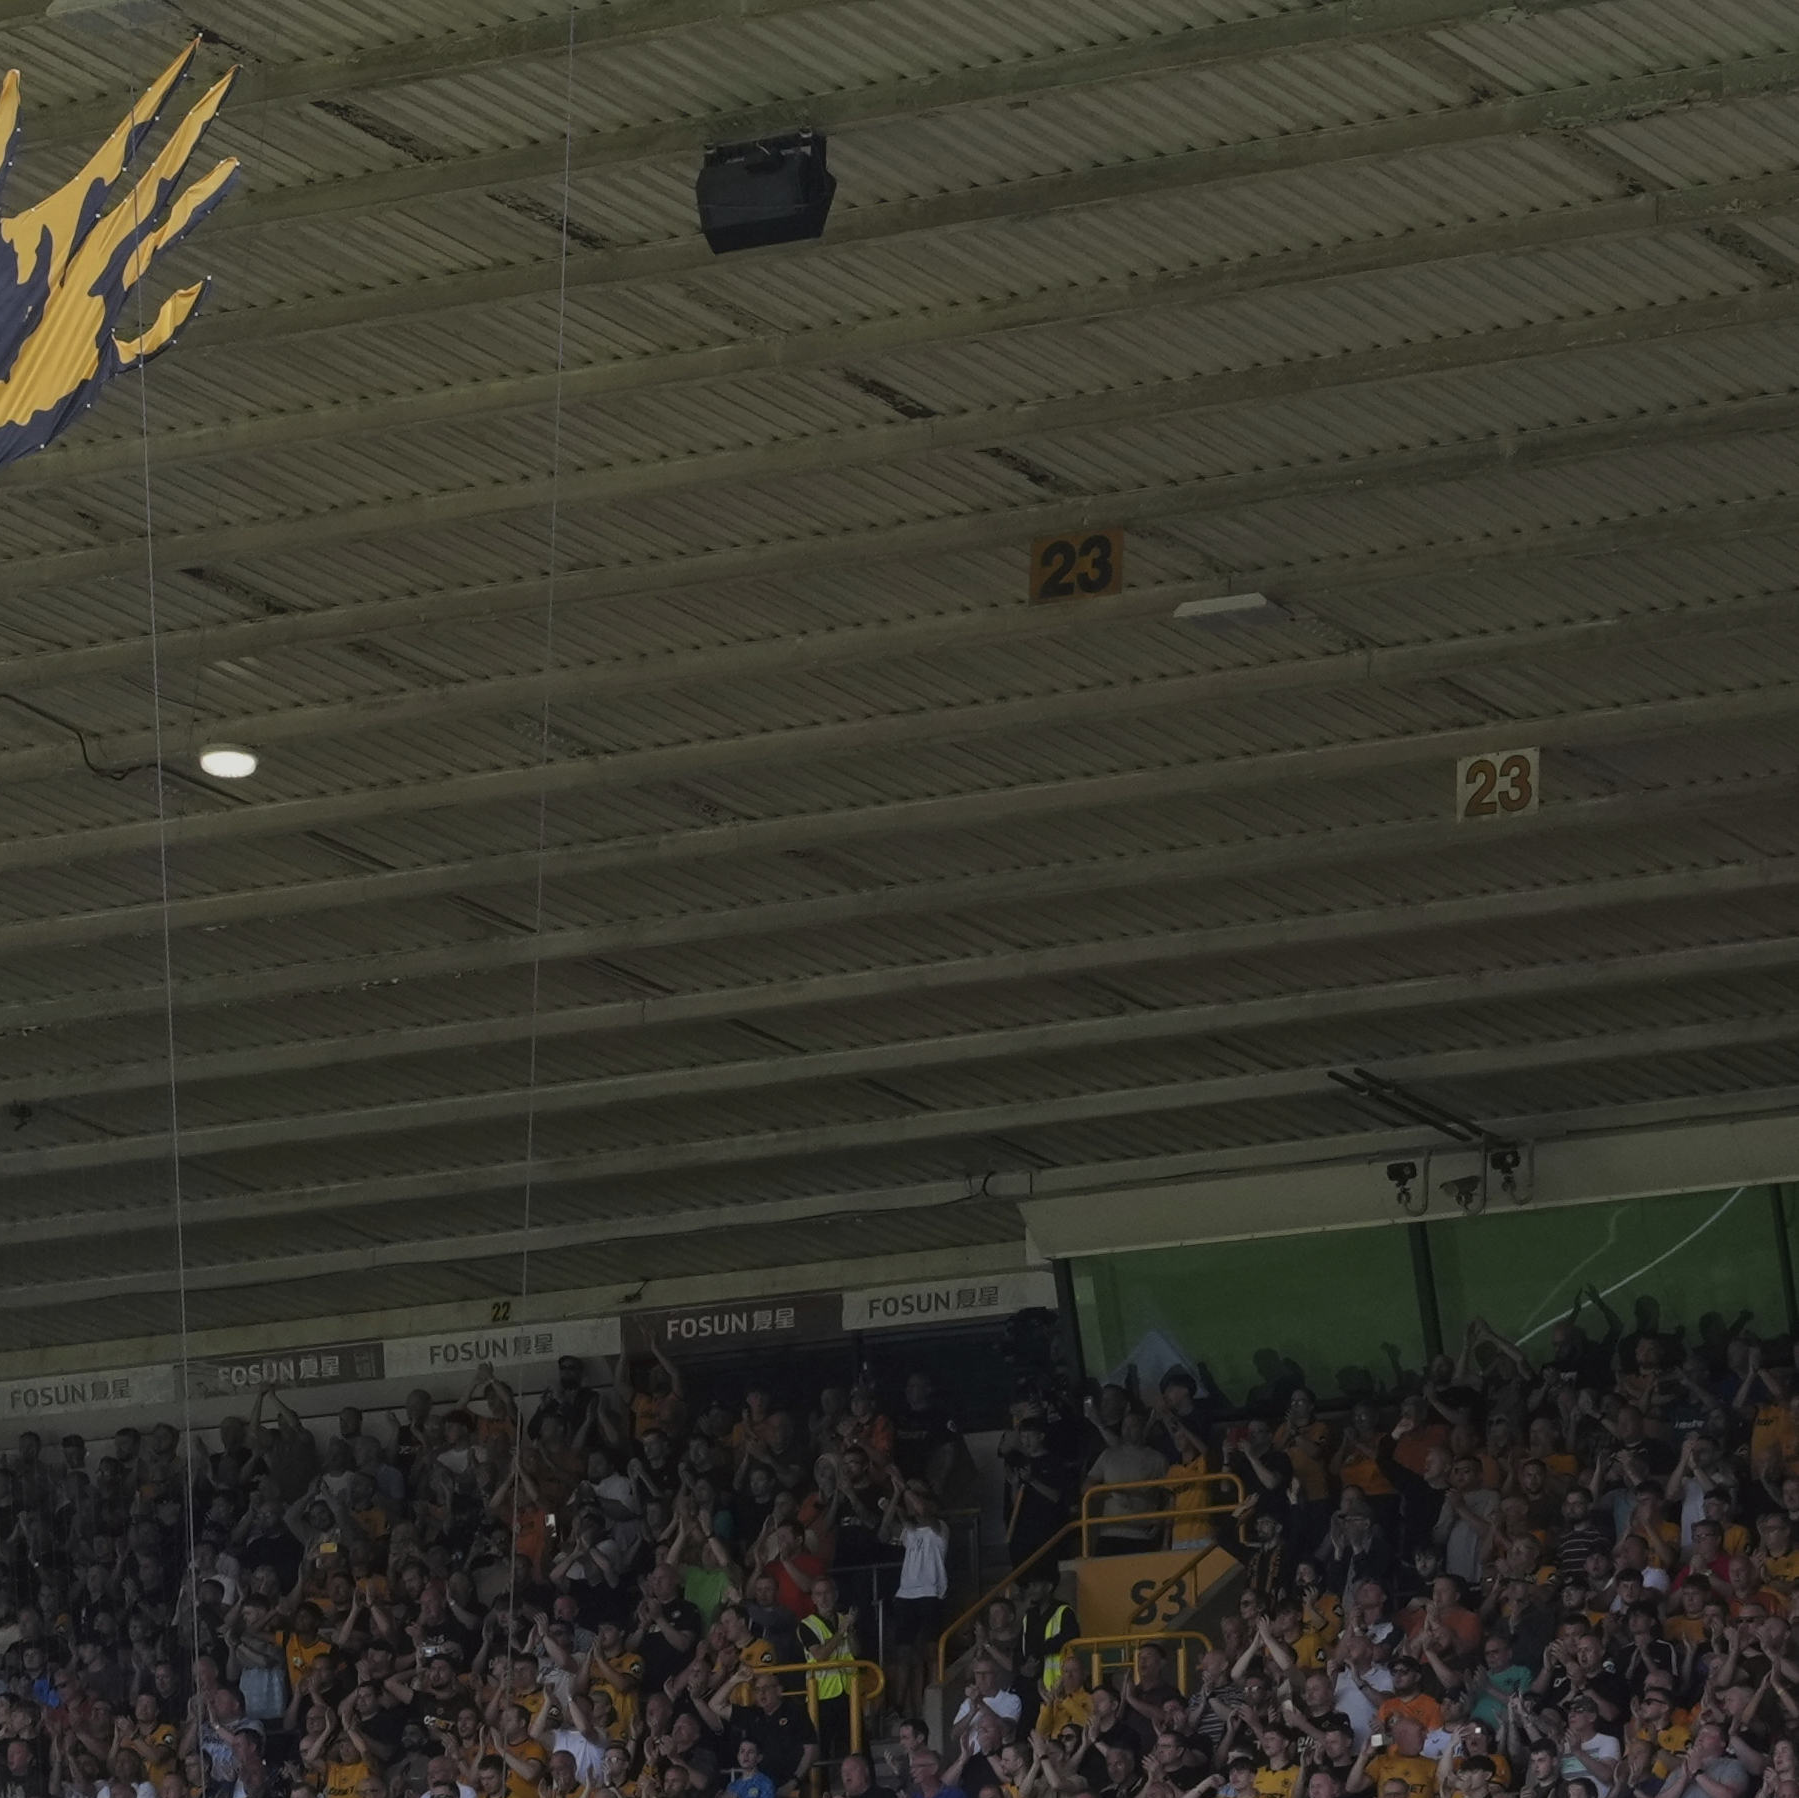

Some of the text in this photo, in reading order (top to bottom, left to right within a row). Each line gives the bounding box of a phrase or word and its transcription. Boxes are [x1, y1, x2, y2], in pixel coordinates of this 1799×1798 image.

[1038, 534, 1115, 599] 23
[1463, 754, 1534, 819] 23
[491, 1302, 511, 1322] 22
[868, 1291, 951, 1319] FOSUN
[666, 1312, 747, 1341] FOSUN
[429, 1336, 507, 1366] FOSUN
[218, 1360, 295, 1387] FOSUN
[10, 1383, 85, 1409] FOSUN
[1131, 1577, 1188, 1626] S3
